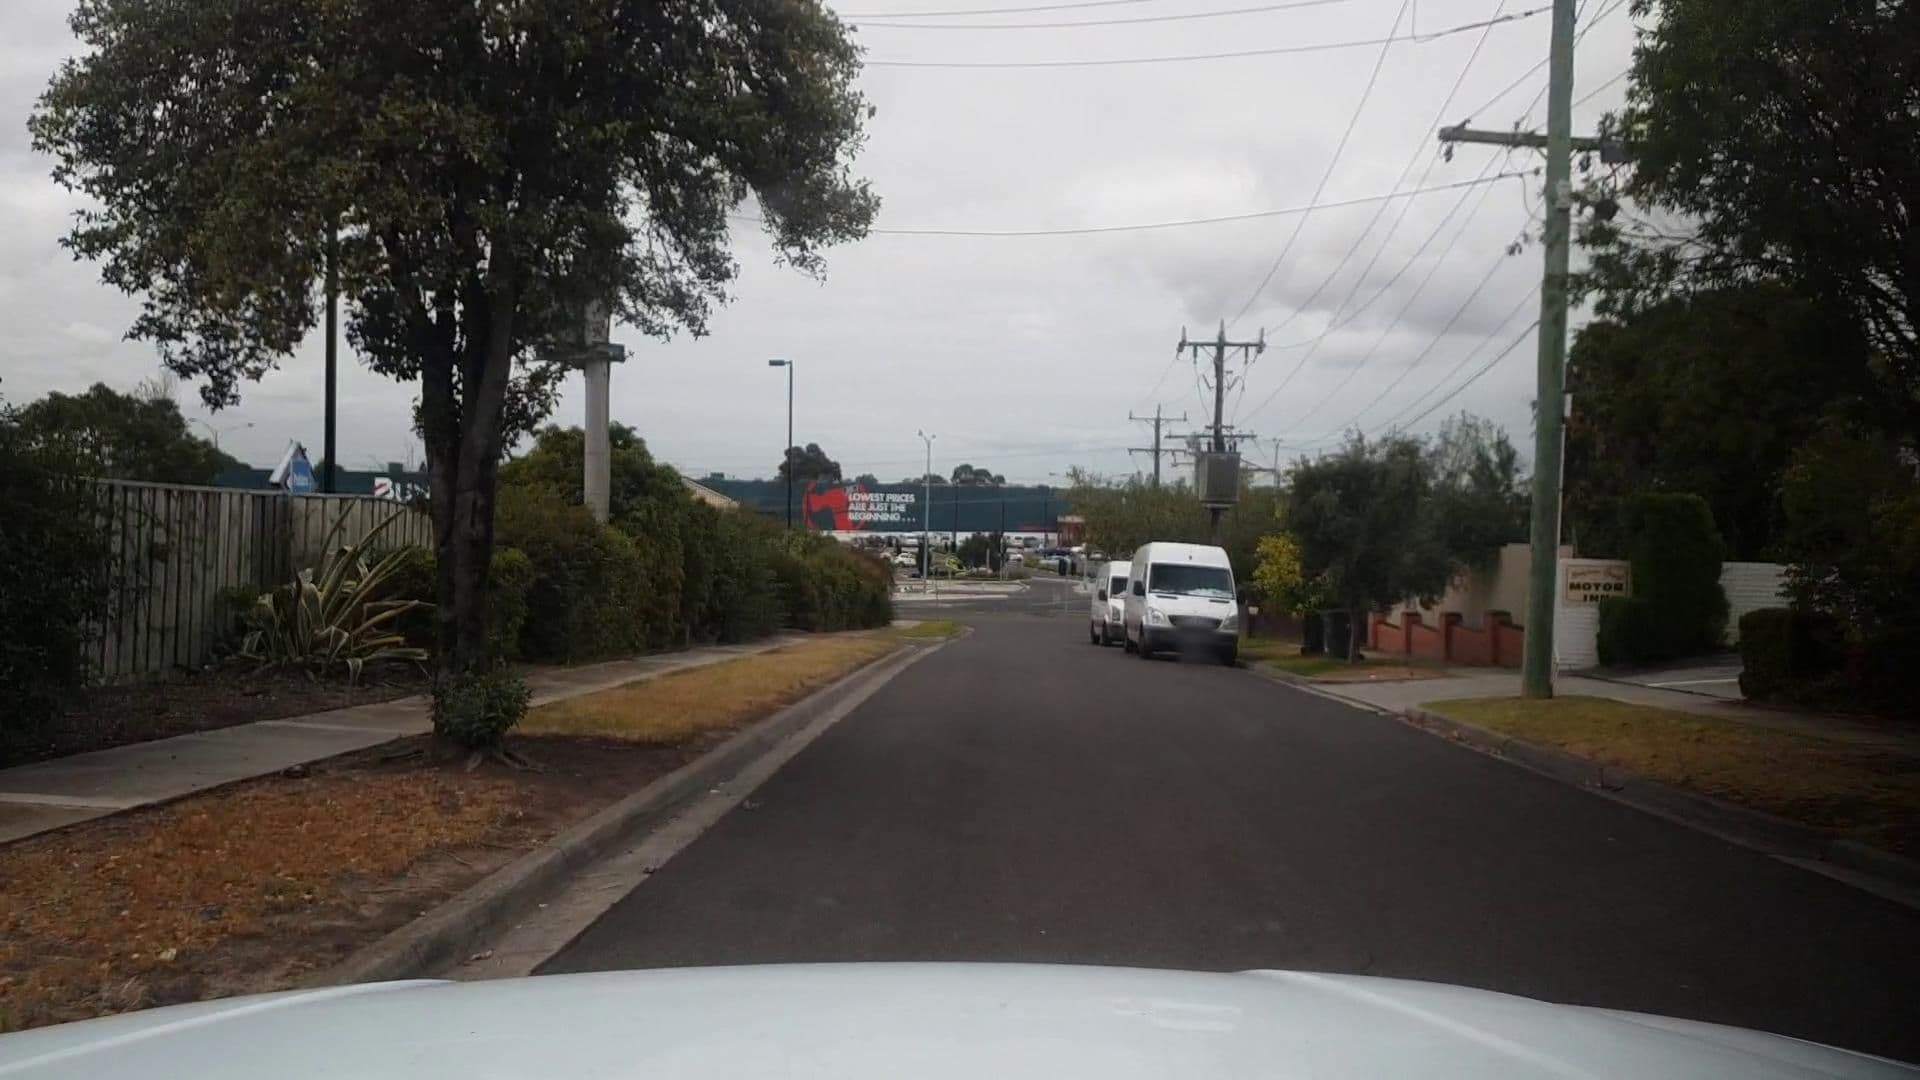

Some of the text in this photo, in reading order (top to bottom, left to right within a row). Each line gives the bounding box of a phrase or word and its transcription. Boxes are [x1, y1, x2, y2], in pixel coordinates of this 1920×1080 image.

[848, 492, 915, 503] LOWEST PRICES
[848, 502, 906, 512] ARE JUST THE
[1569, 581, 1623, 591] MOTOR
